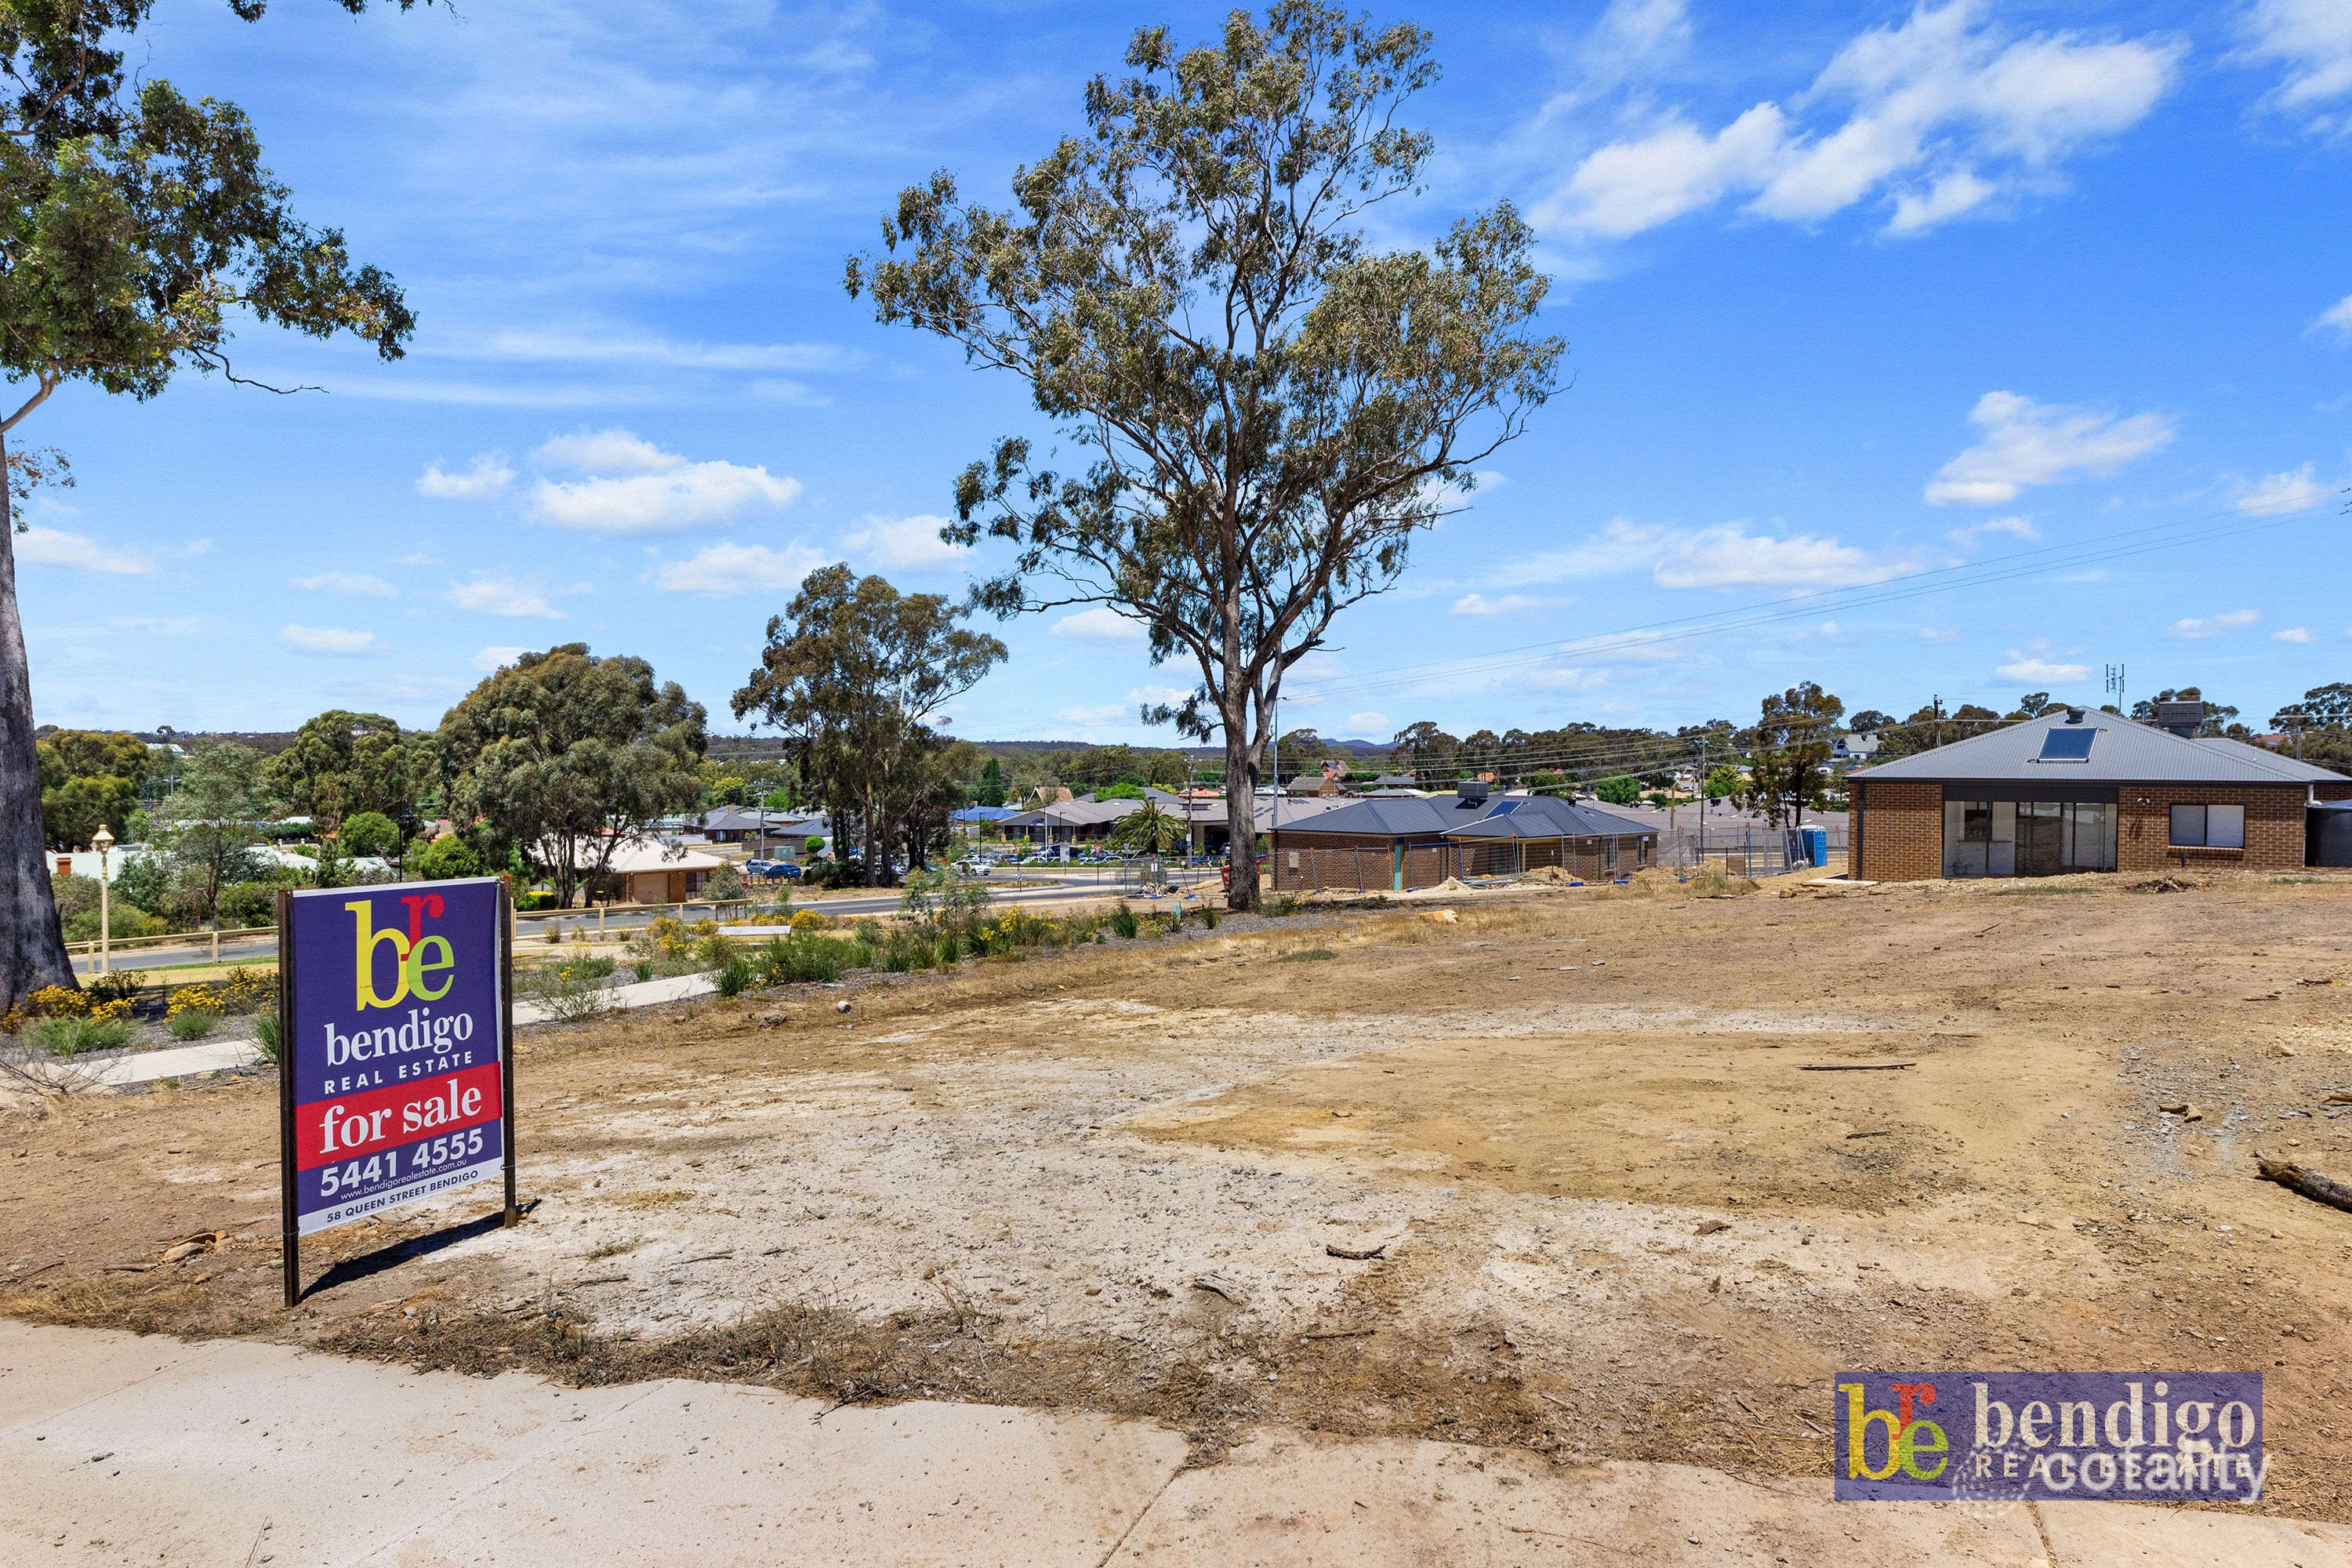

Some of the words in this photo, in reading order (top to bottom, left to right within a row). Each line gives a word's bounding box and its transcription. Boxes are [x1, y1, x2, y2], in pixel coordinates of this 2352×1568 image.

[324, 1007, 474, 1067] bendigo
[325, 1071, 383, 1094] REAL
[398, 1051, 472, 1079] ESTATE
[319, 1105, 392, 1154] for
[403, 1078, 481, 1134] sale
[321, 1151, 397, 1197] 5441
[412, 1127, 483, 1169] 4555
[340, 1159, 467, 1200] www.bendigorealestate.com.au
[327, 1210, 341, 1223] 58
[345, 1197, 386, 1217] QUEEN
[390, 1185, 426, 1204] STREET
[430, 1170, 478, 1192] BENDIGO
